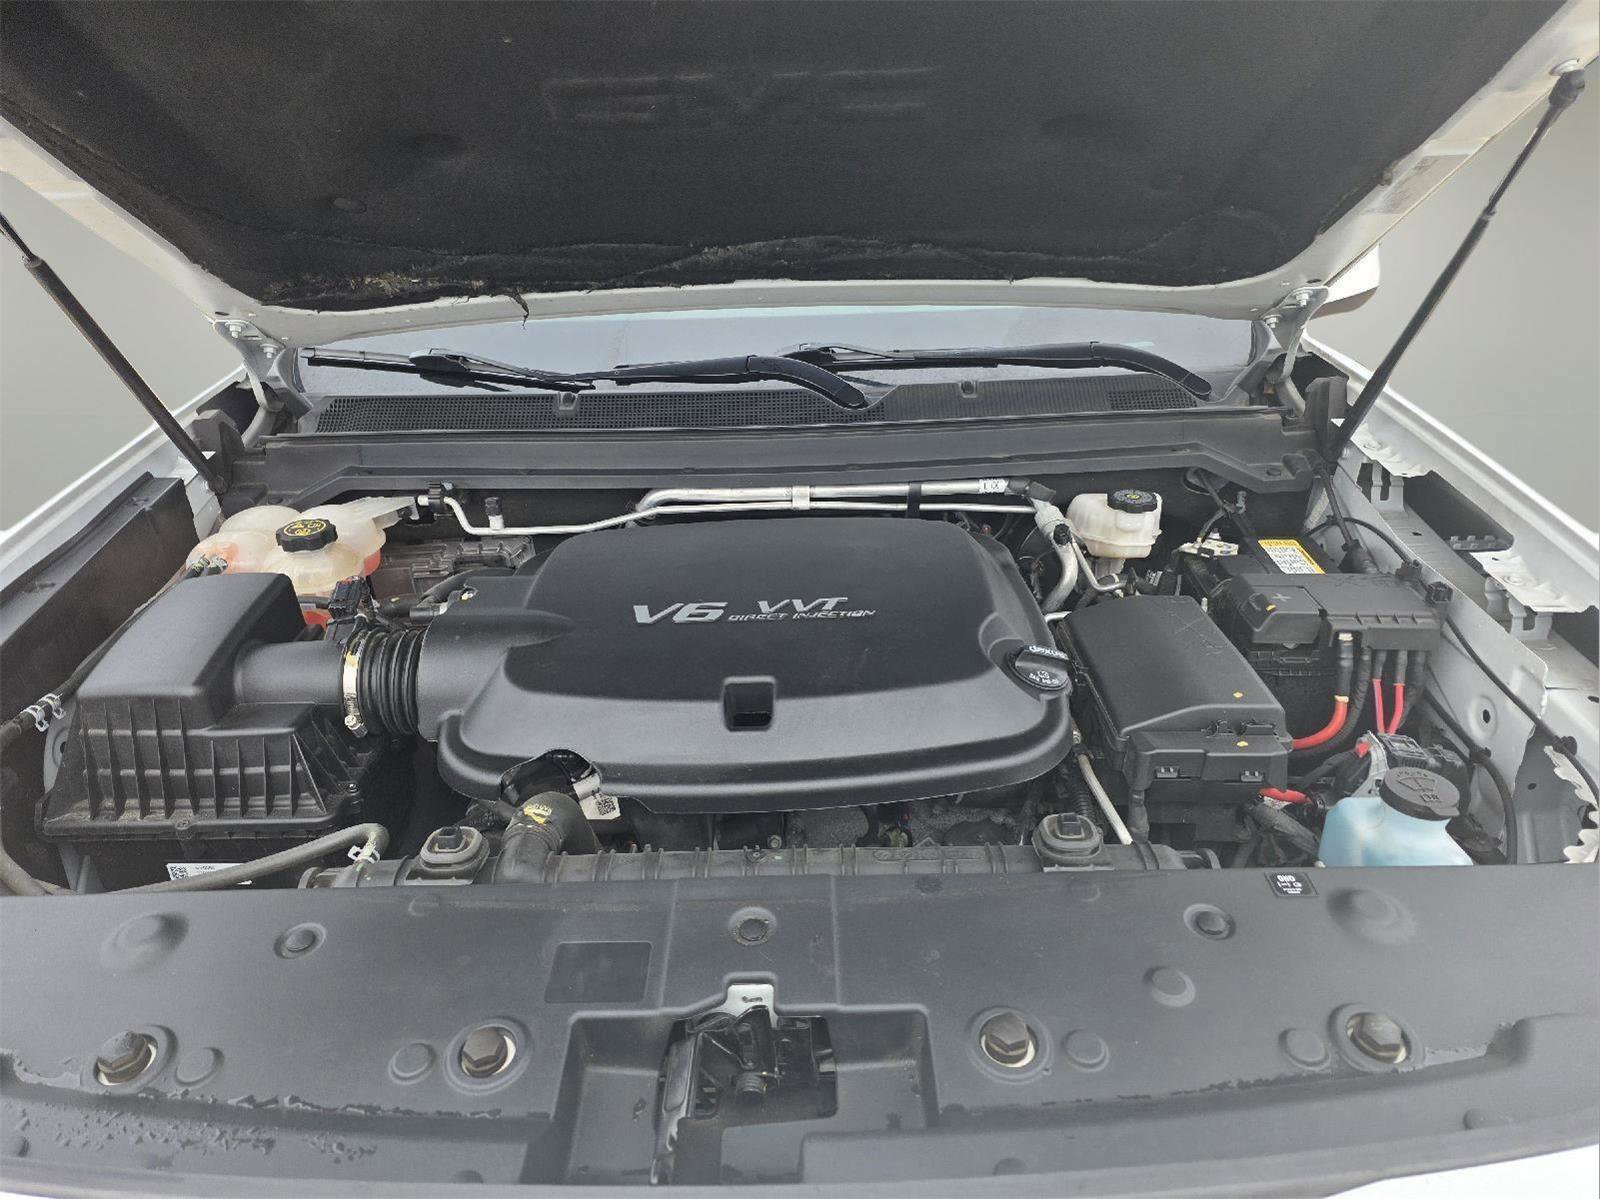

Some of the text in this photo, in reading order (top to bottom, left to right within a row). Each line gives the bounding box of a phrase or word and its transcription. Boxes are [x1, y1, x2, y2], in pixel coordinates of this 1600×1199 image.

[633, 602, 728, 624] V6
[757, 597, 848, 613] VVT
[728, 609, 876, 621] DIRECT INJECTION
